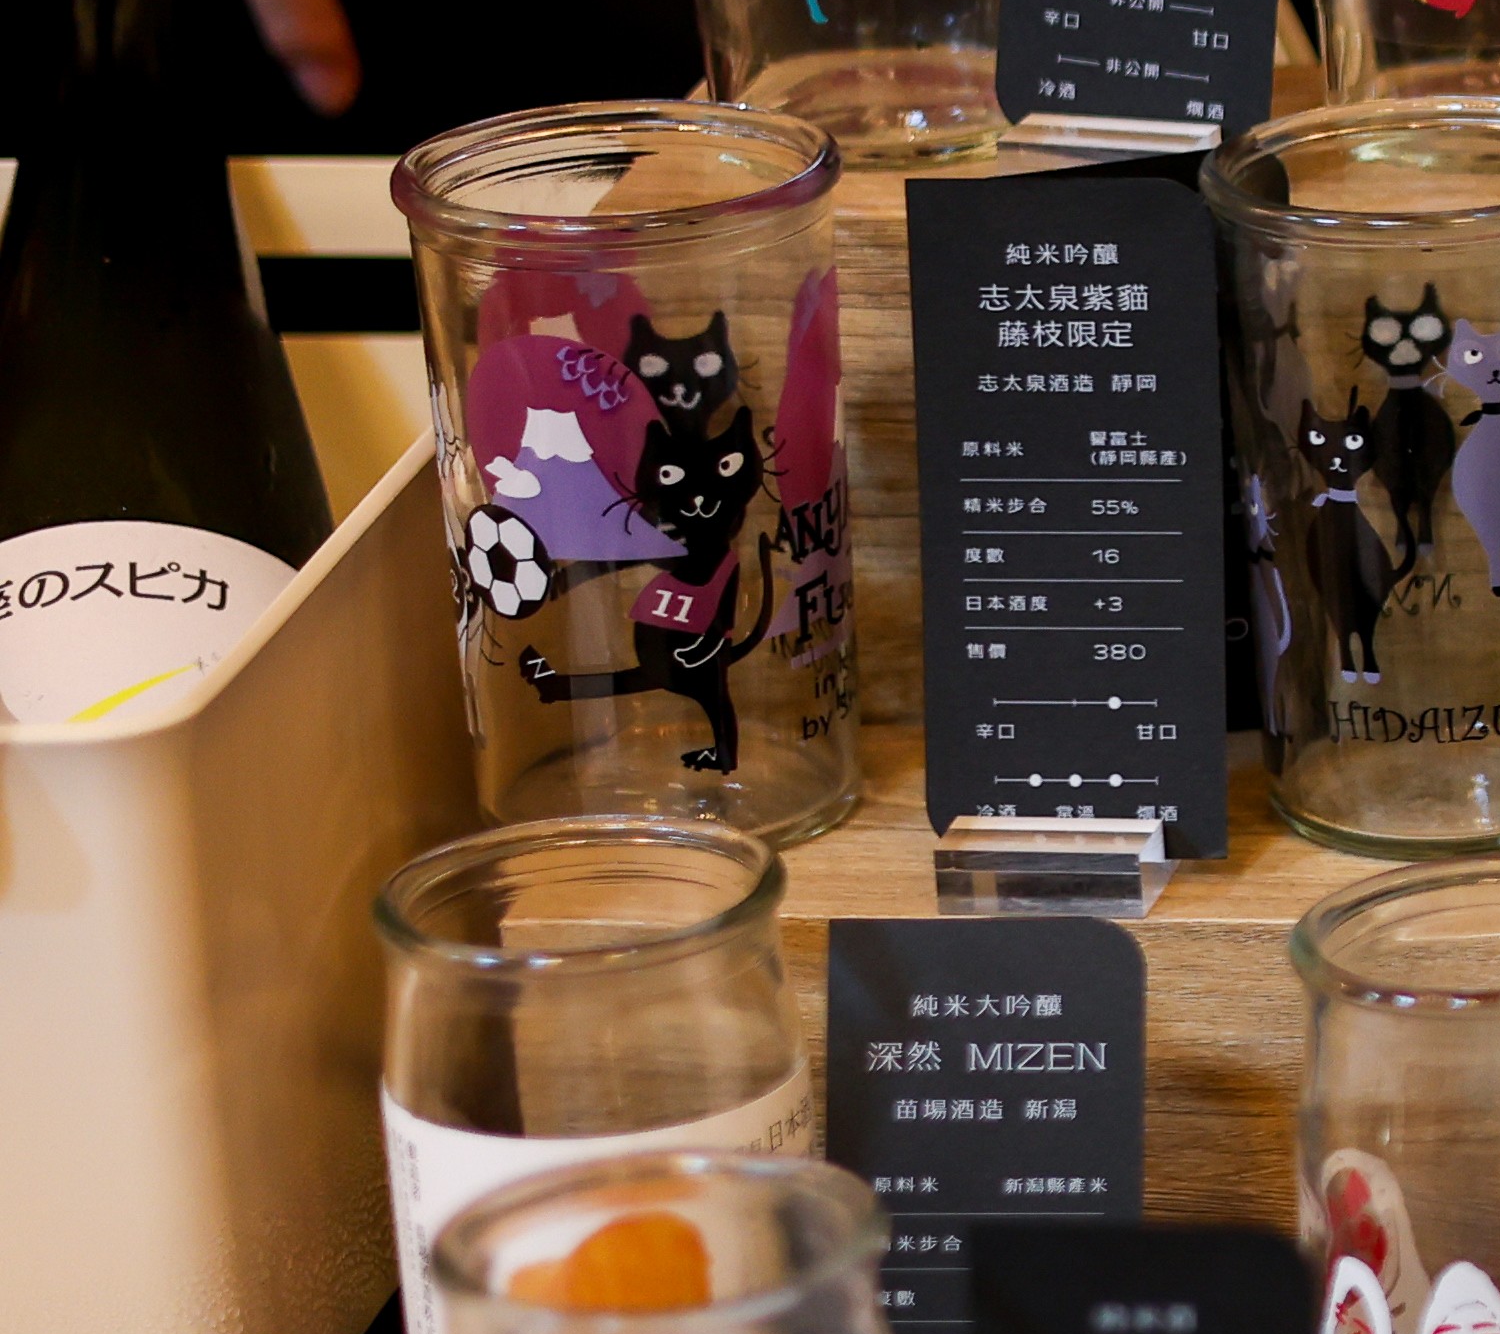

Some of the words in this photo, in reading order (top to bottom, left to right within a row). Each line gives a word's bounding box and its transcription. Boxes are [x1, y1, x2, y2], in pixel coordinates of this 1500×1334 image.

[979, 284, 1148, 311] 志太泉紫貓
[999, 320, 1133, 347] 藤枝限定
[978, 374, 1093, 392] 志太泉酒造
[1092, 500, 1138, 514] 55%
[652, 589, 692, 622] 11
[1095, 597, 1122, 611] +3
[1094, 644, 1146, 660] 380
[868, 1041, 941, 1071] 深然
[969, 1043, 1107, 1071] MIZEN
[897, 1099, 1003, 1119] 苗場酒造
